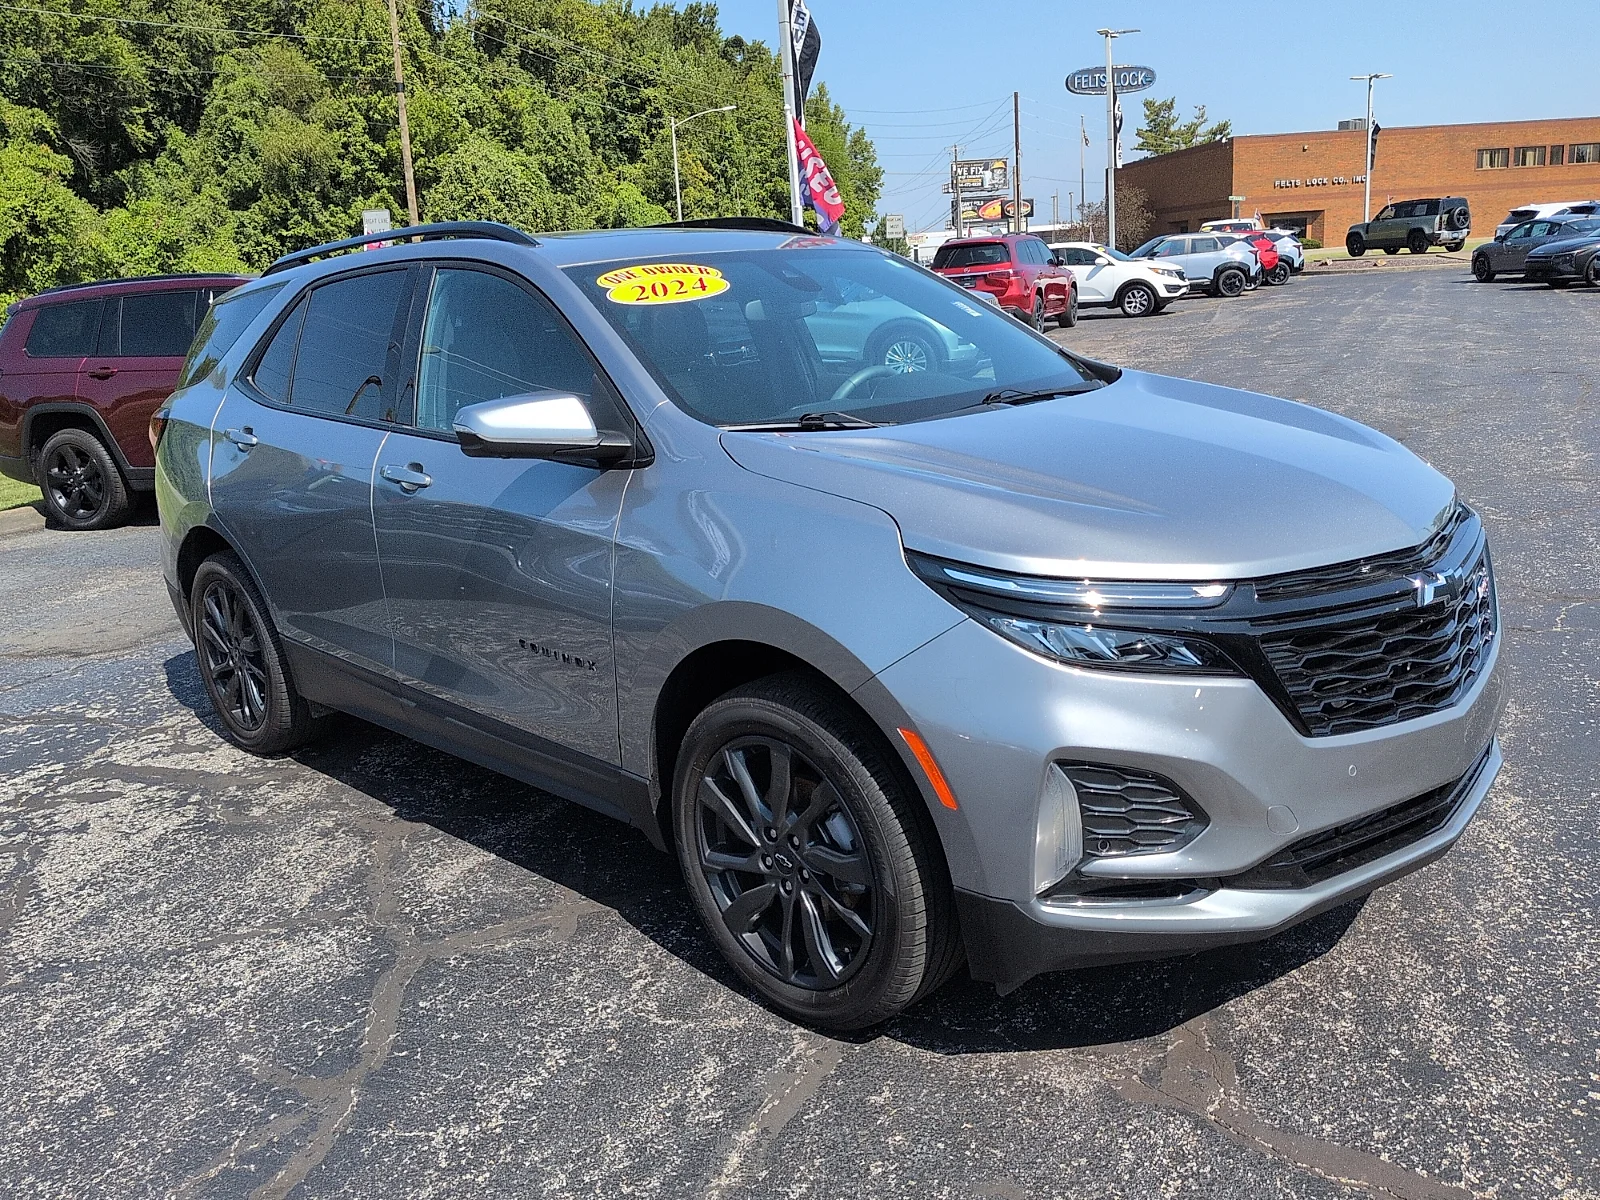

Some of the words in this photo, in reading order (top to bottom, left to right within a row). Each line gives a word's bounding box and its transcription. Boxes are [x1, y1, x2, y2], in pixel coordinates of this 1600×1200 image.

[1074, 73, 1107, 88] FELTS
[1114, 71, 1147, 87] LOCK
[970, 166, 984, 175] FIX
[1274, 179, 1301, 189] FELTS
[1305, 177, 1328, 187] LOCK
[603, 269, 641, 285] ONE
[641, 265, 711, 276] OWNER
[631, 277, 708, 301] 2024
[518, 638, 597, 672] EQUINOX
